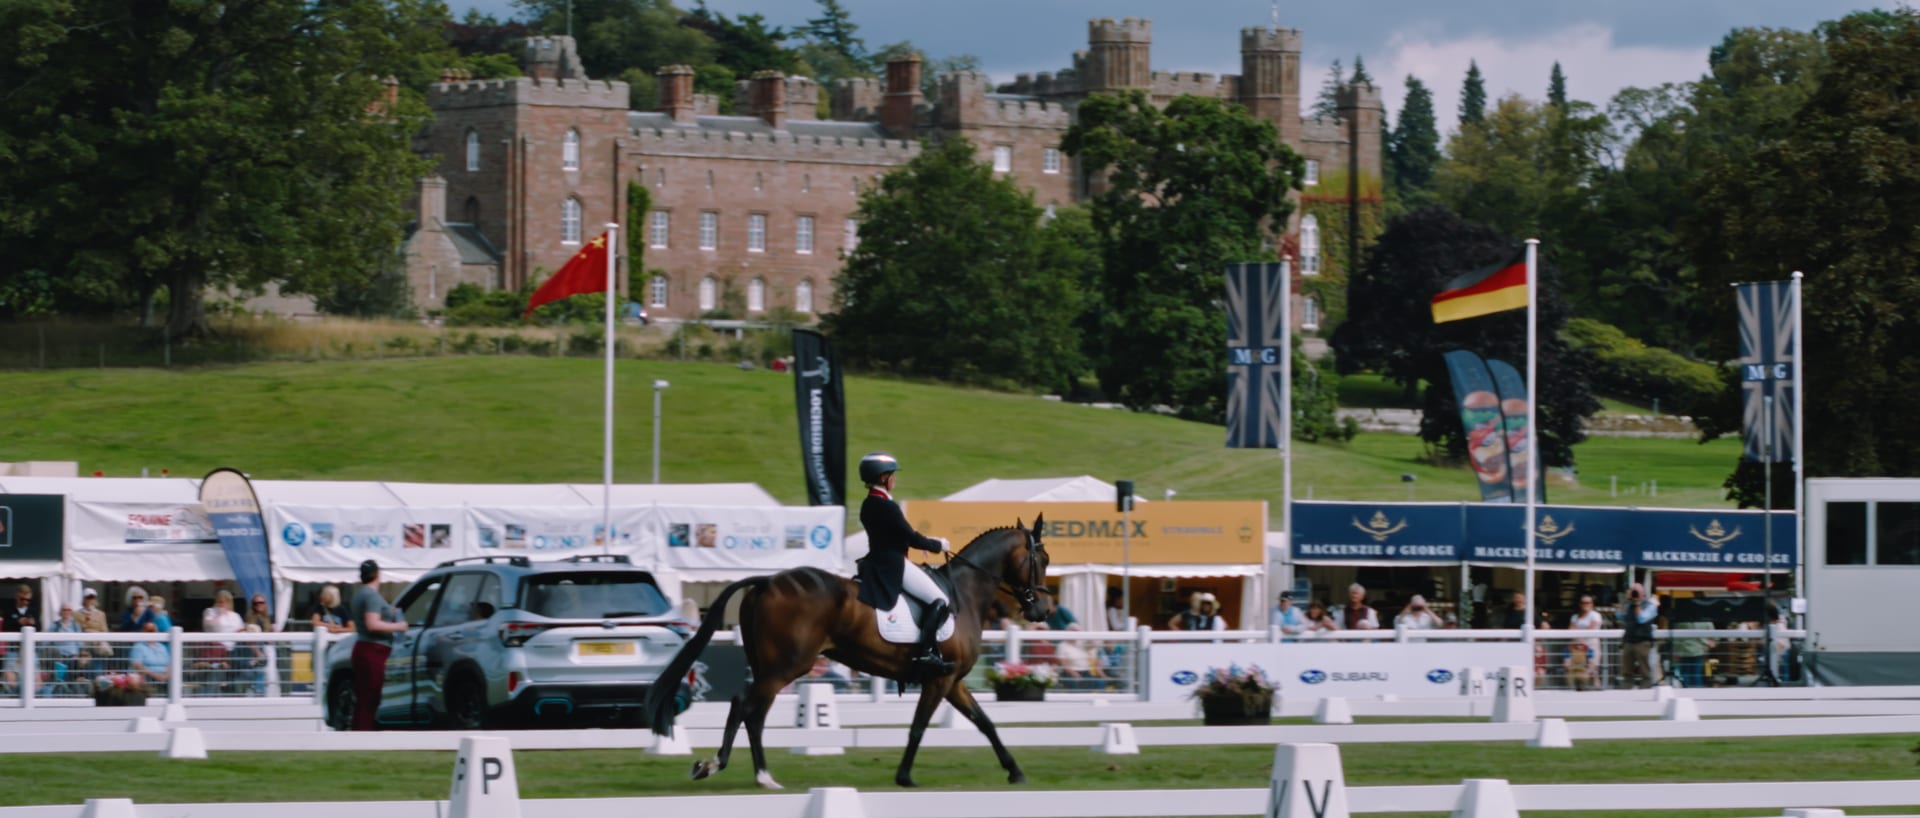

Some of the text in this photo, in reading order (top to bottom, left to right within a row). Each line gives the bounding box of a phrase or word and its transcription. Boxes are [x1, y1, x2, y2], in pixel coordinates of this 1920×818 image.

[1040, 520, 1147, 538] BEDMAX
[340, 534, 394, 549] ONEY
[533, 535, 585, 549] ONEY
[723, 535, 777, 549] ONEY
[1300, 543, 1383, 555] MACKENZIE
[1399, 544, 1455, 556] GEORGE
[1474, 546, 1554, 559] MACKENIE
[1569, 549, 1622, 560] GEORGE
[1642, 551, 1720, 562] MACKENZIE
[1331, 672, 1388, 682] SUBARU
[1514, 676, 1528, 697] R
[816, 703, 830, 728] E
[482, 757, 503, 795] P
[1303, 779, 1333, 818] V
